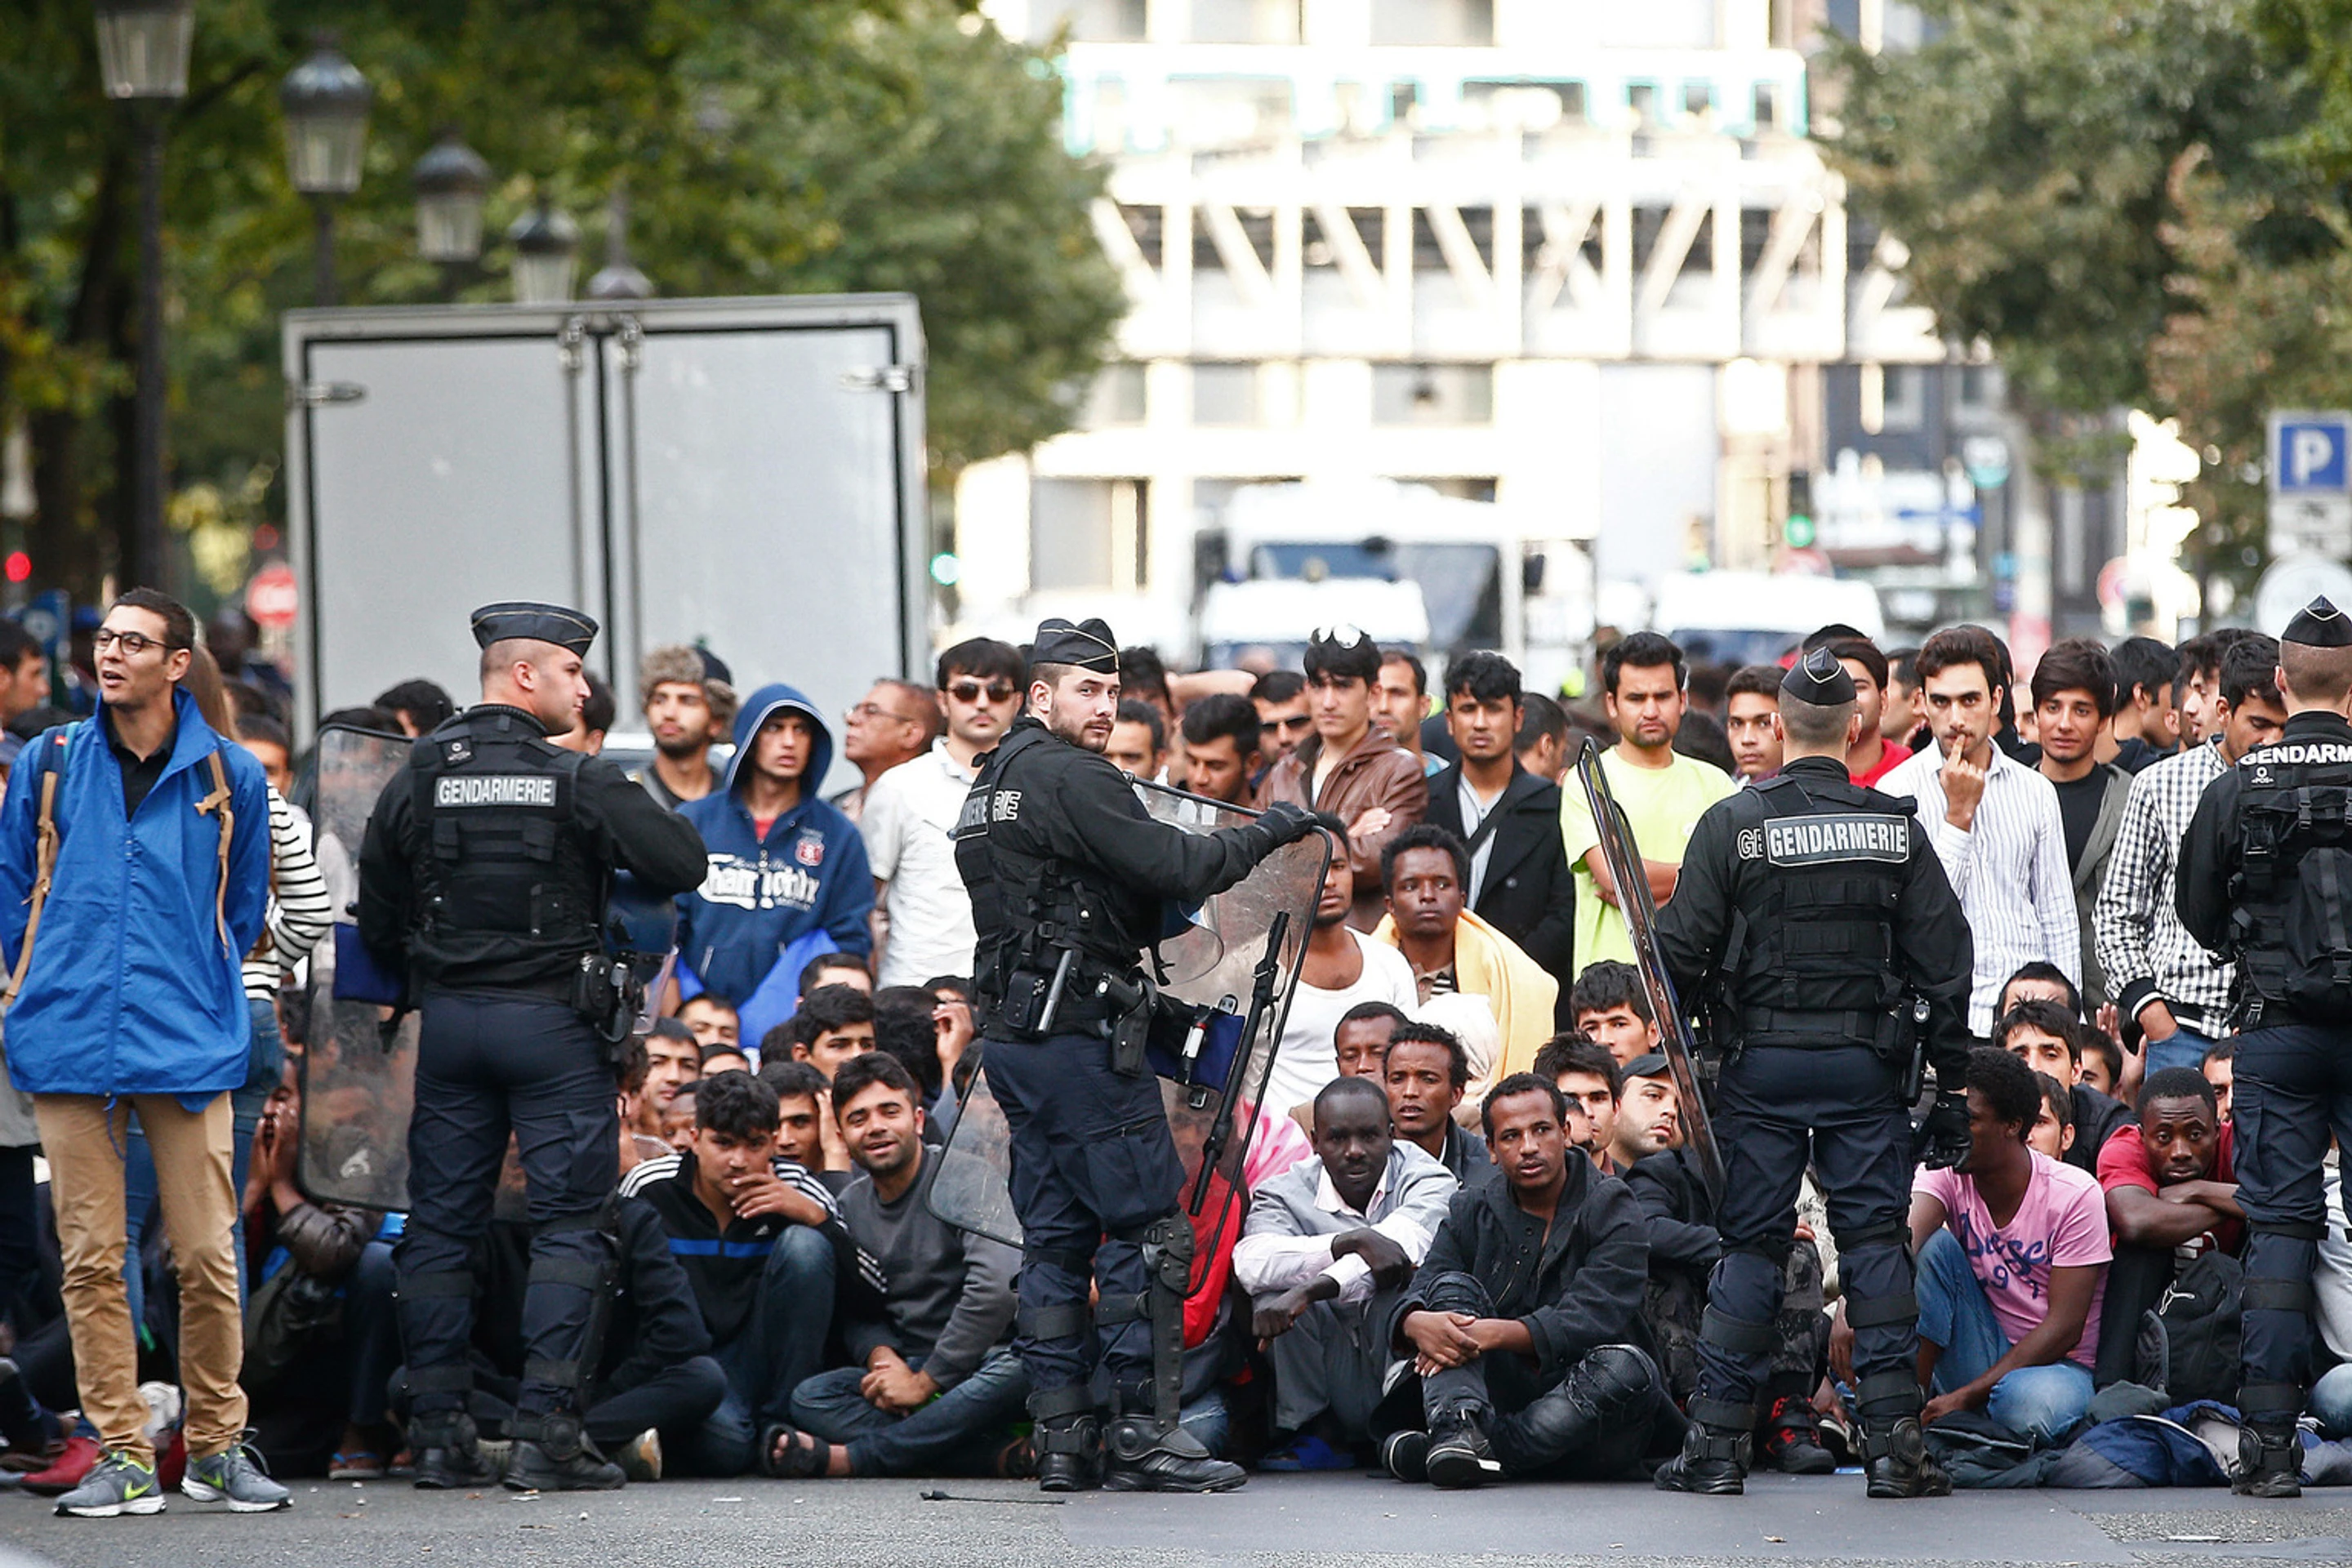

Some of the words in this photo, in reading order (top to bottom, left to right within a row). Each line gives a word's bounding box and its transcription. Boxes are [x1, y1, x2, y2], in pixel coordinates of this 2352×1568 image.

[2292, 429, 2333, 485] P
[439, 778, 553, 804] GENDARMERIE
[1769, 822, 1907, 858] GENDARMERIE
